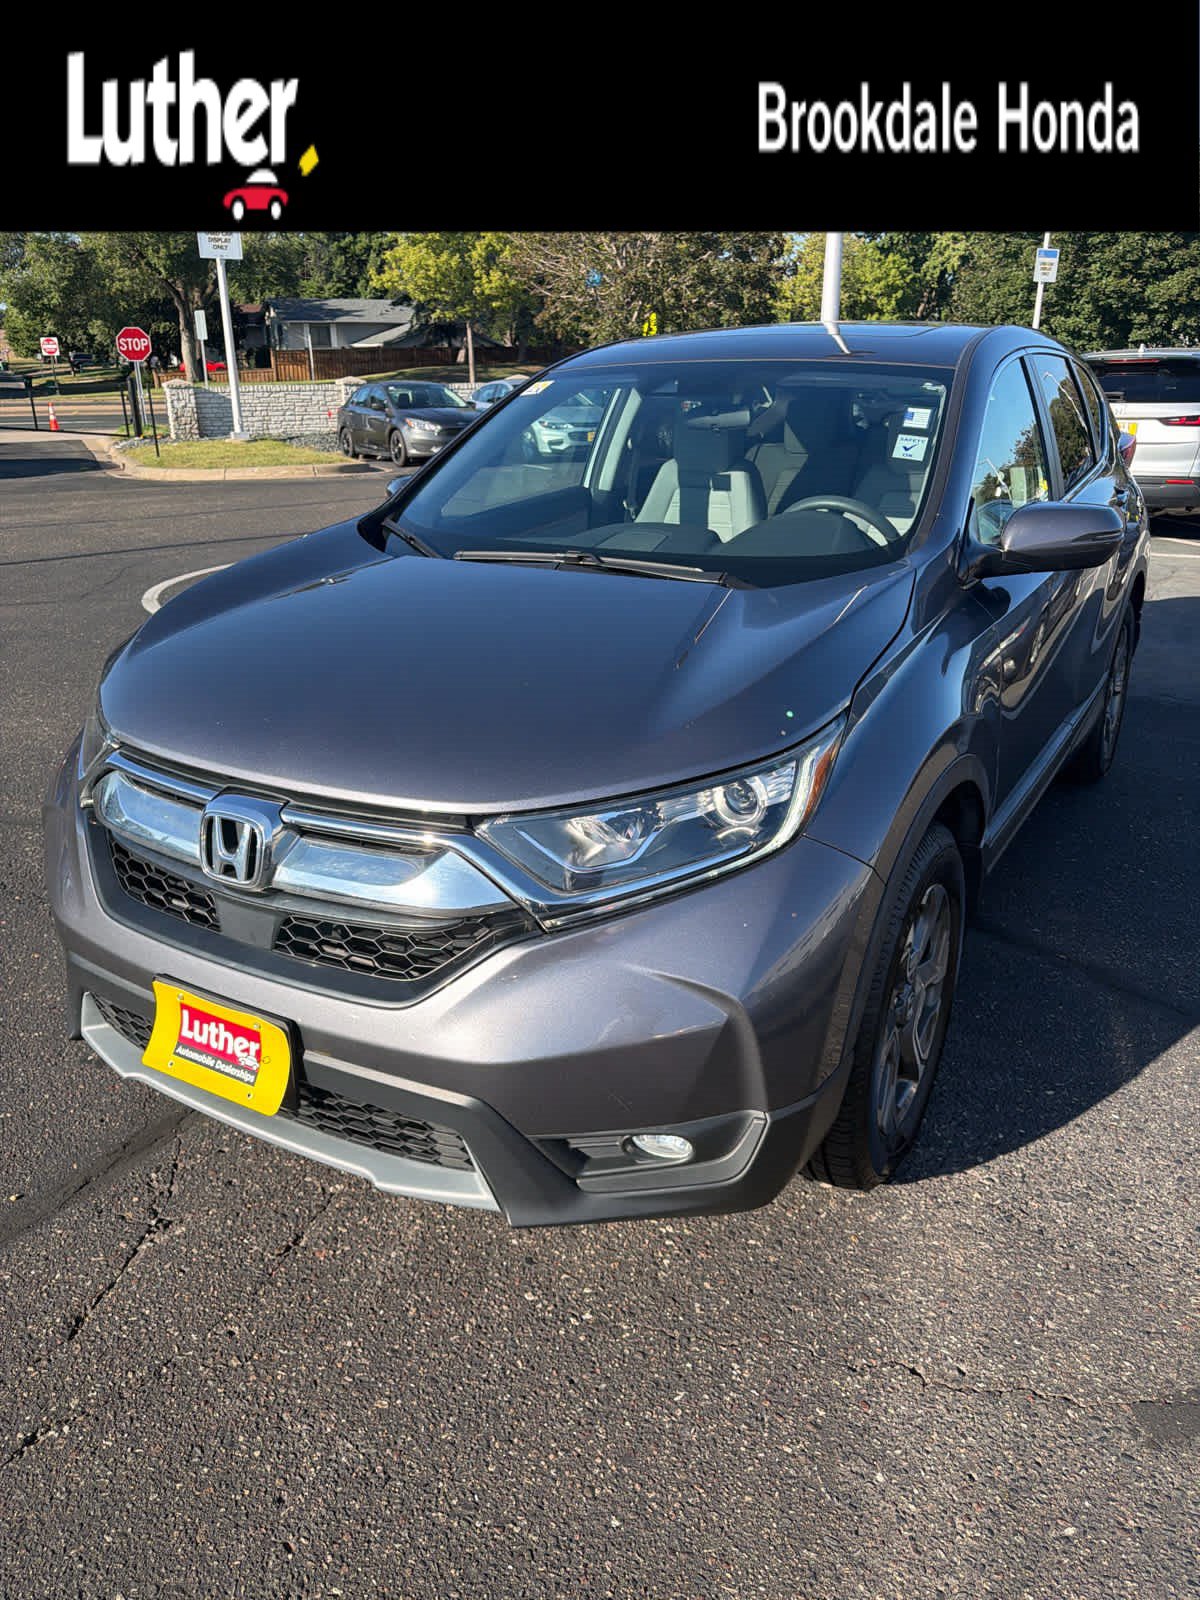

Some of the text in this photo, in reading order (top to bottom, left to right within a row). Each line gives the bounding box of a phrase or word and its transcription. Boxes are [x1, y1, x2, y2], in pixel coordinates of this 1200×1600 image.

[119, 338, 149, 352] STOP
[181, 1009, 260, 1058] Luther
[175, 1045, 255, 1083] Automobile Dealerships
